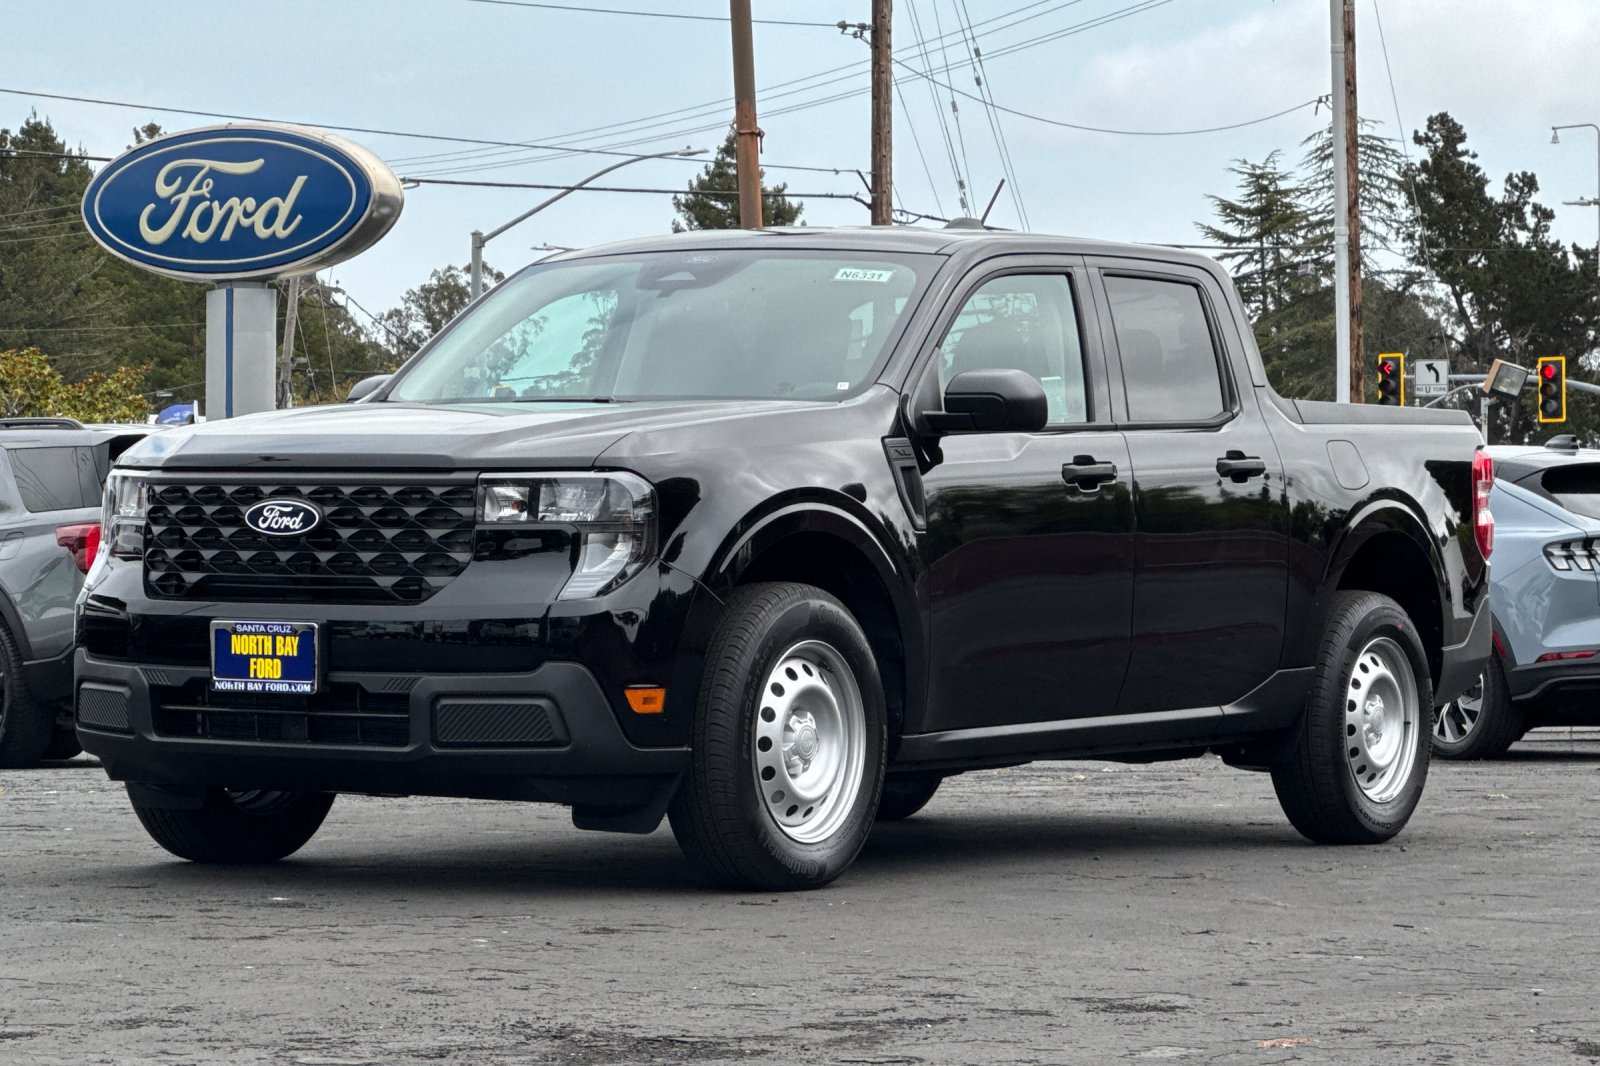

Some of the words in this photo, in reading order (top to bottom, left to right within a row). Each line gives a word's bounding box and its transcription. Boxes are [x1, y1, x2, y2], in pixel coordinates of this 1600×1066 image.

[139, 158, 308, 245] Ford
[840, 270, 883, 280] N6331
[894, 448, 912, 456] XL
[258, 505, 305, 530] Ford
[235, 624, 266, 632] SANTA
[267, 625, 292, 633] CRUZ
[231, 634, 273, 656] NORTH
[275, 635, 300, 657] BAY
[249, 657, 282, 679] FORD
[214, 681, 245, 690] NORTH
[246, 682, 264, 691] BAY
[265, 682, 311, 692] FORD.COM
